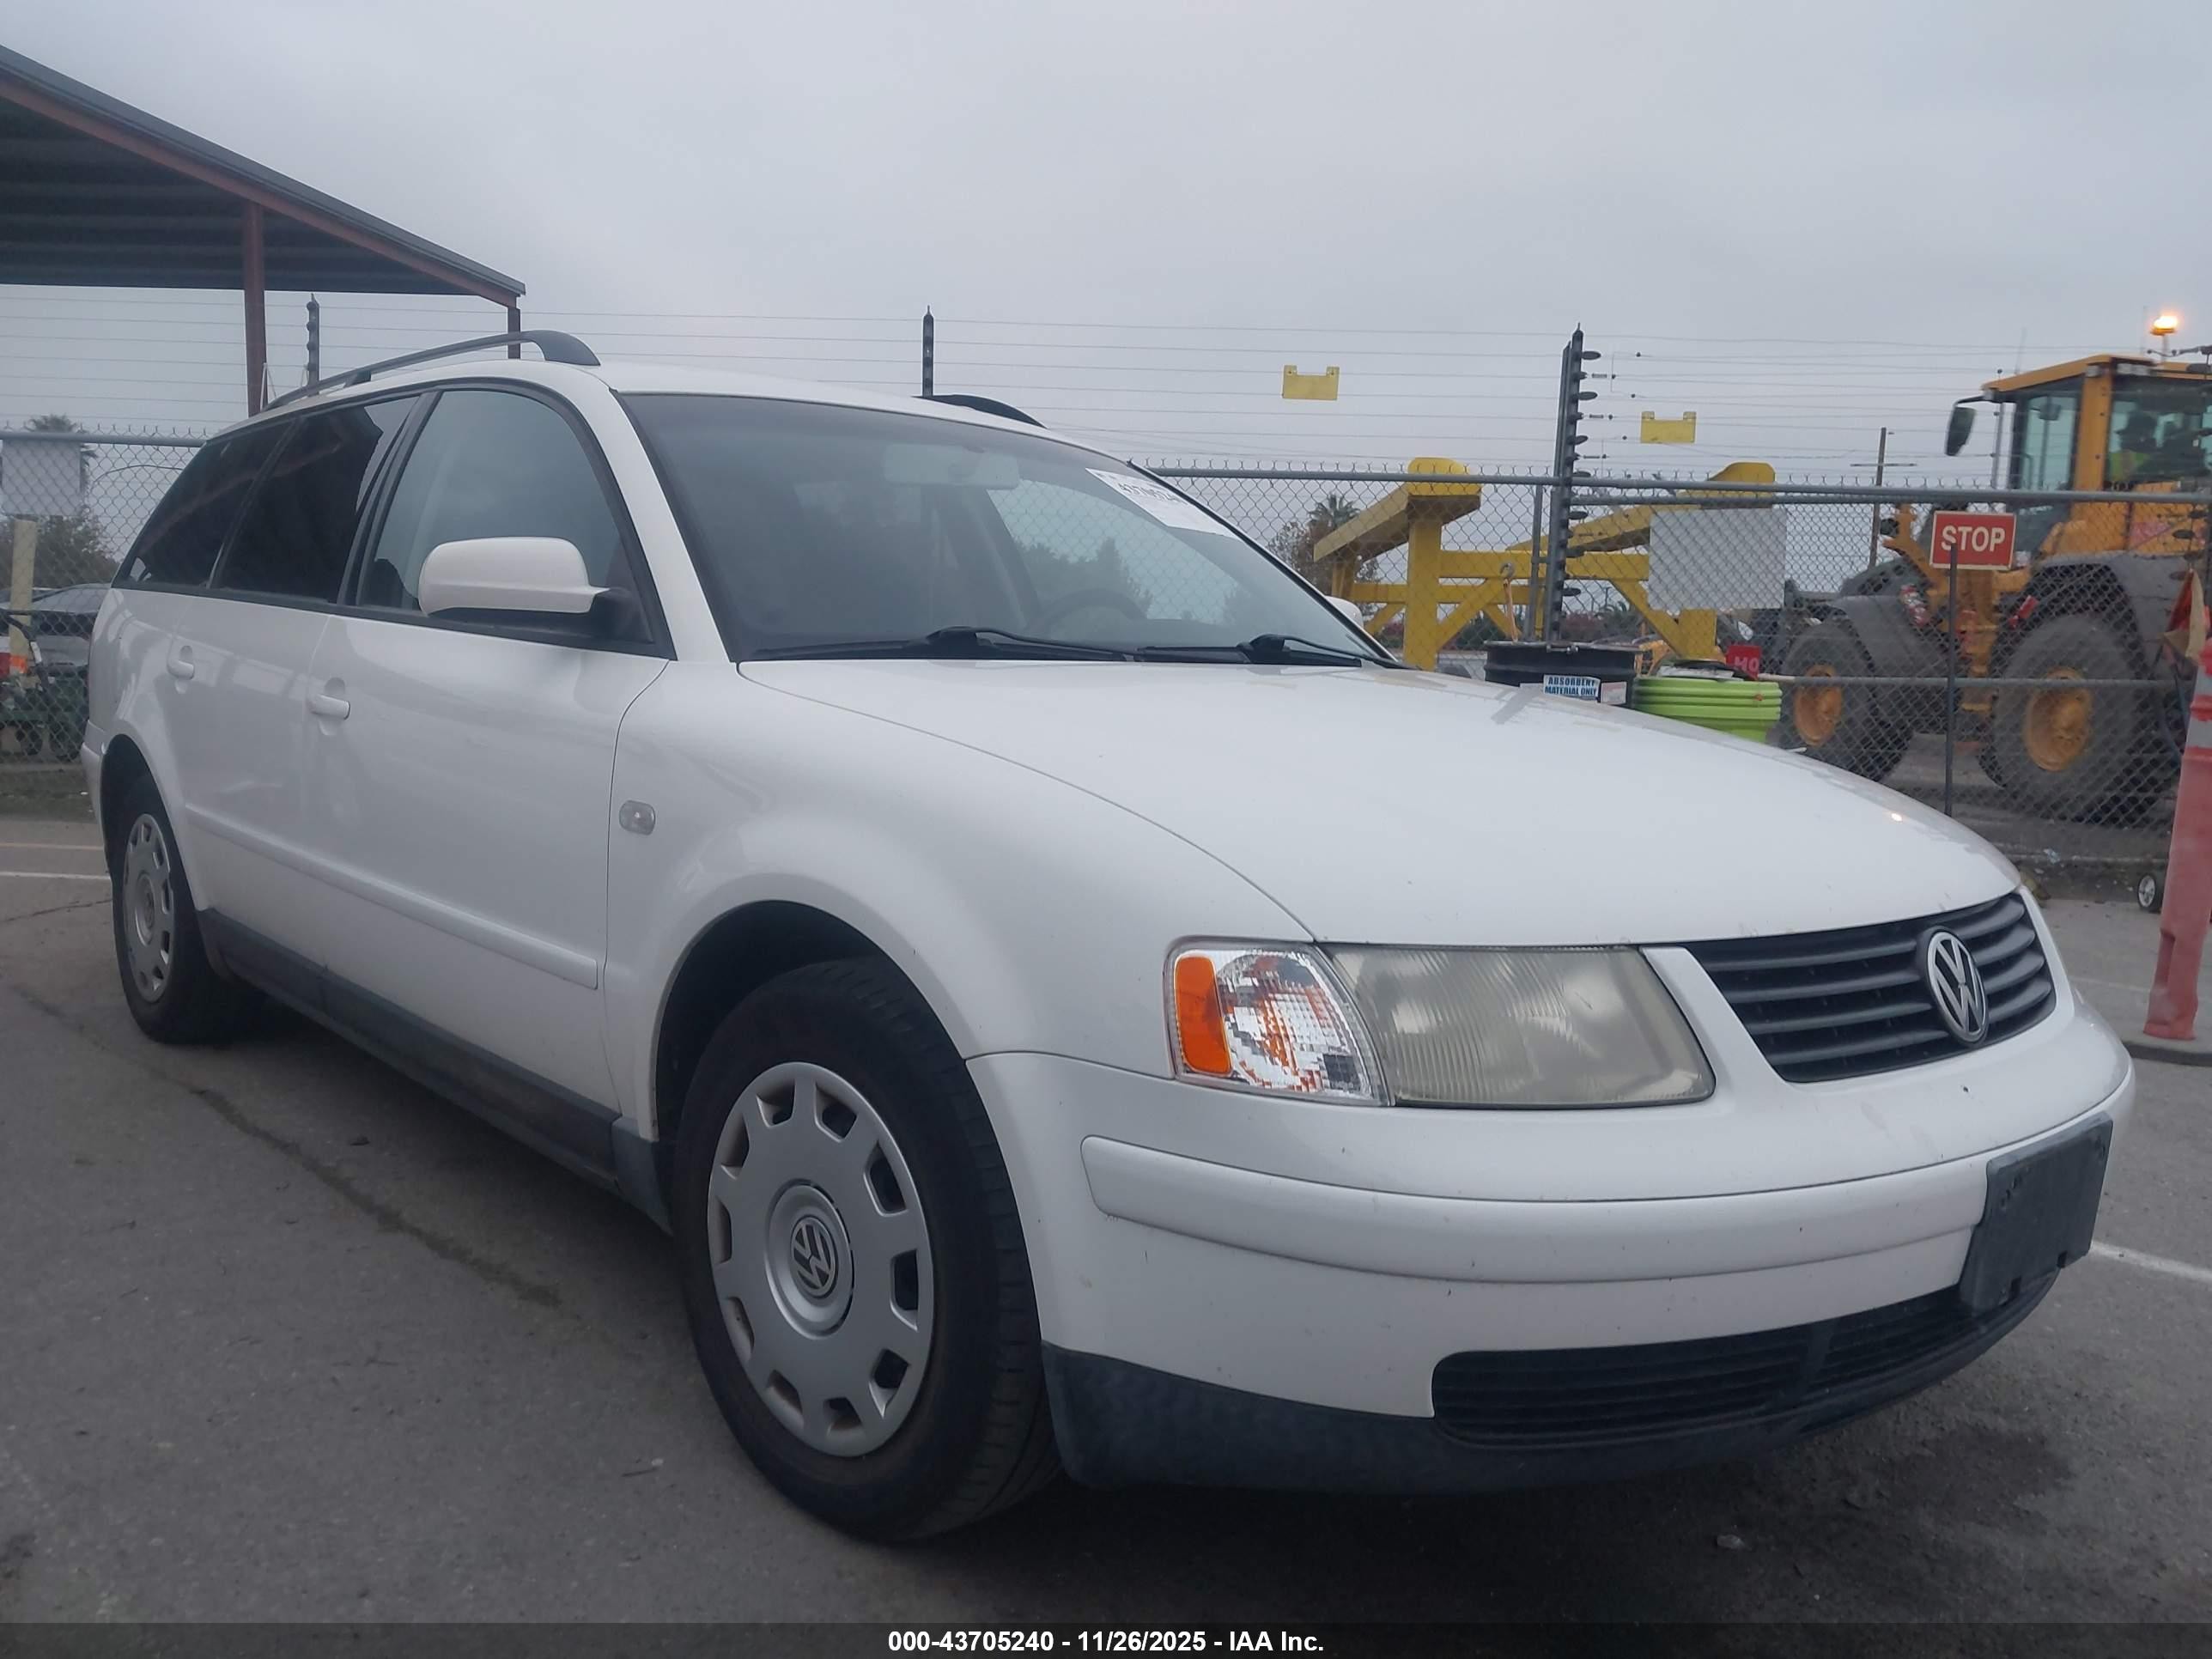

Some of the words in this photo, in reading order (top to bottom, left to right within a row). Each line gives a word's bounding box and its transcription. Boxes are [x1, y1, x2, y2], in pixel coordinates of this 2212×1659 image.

[1941, 525, 2006, 552] STOP
[1547, 676, 1595, 687] ABSORBENT
[1544, 686, 1580, 695] MATERIAL
[1580, 687, 1597, 696] ONLY
